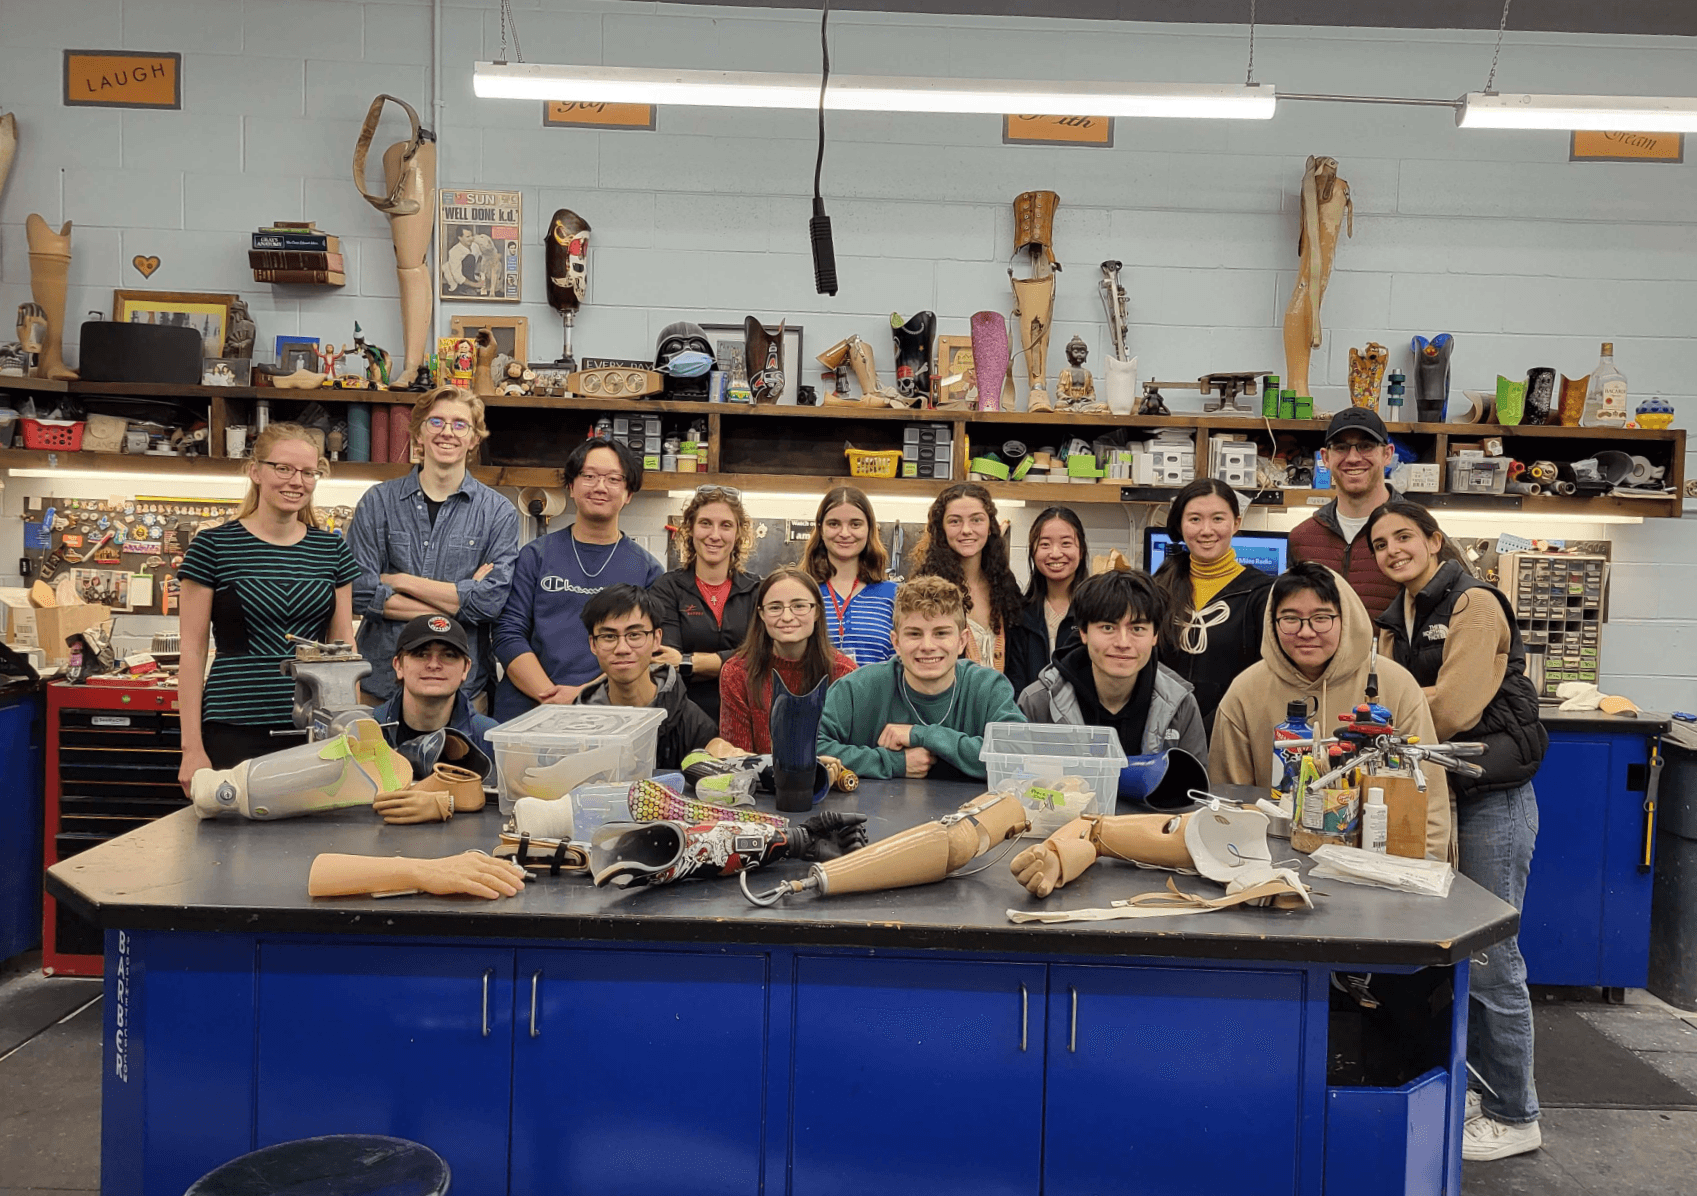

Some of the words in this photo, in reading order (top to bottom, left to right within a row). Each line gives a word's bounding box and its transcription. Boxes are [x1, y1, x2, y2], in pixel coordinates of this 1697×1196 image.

[86, 63, 165, 92] LAUGH
[466, 193, 496, 206] SUN
[471, 208, 496, 221] DONE
[116, 930, 126, 1079] BARBER
